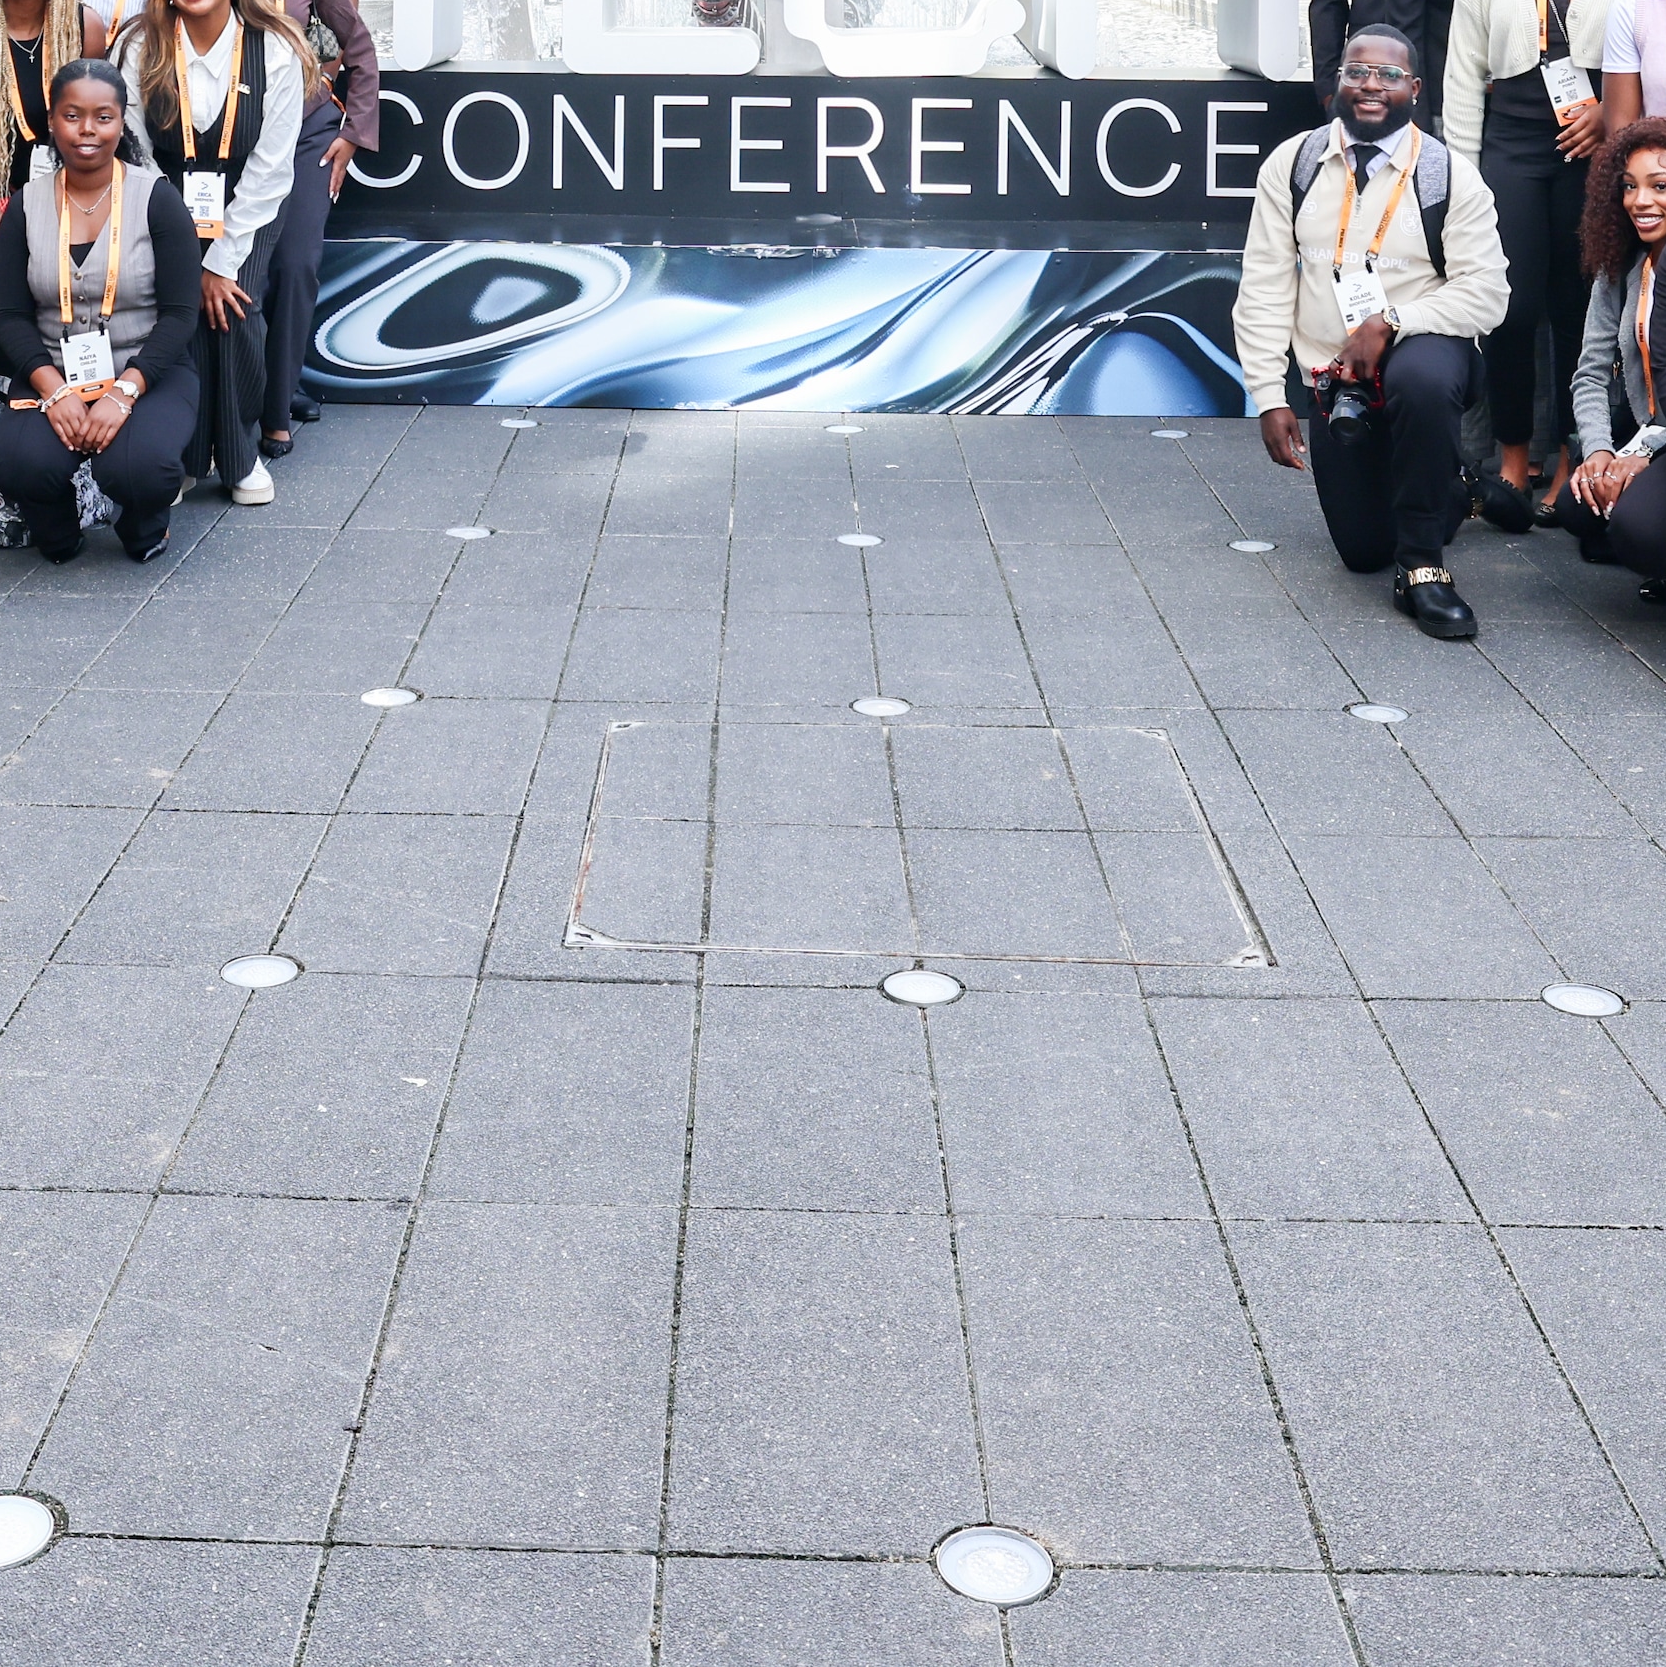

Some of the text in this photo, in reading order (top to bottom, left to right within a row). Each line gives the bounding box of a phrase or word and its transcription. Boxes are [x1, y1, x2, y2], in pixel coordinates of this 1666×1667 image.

[346, 89, 1269, 200] CONFERENCE
[1349, 291, 1372, 302] KOLADE
[79, 353, 97, 361] NAIYA
